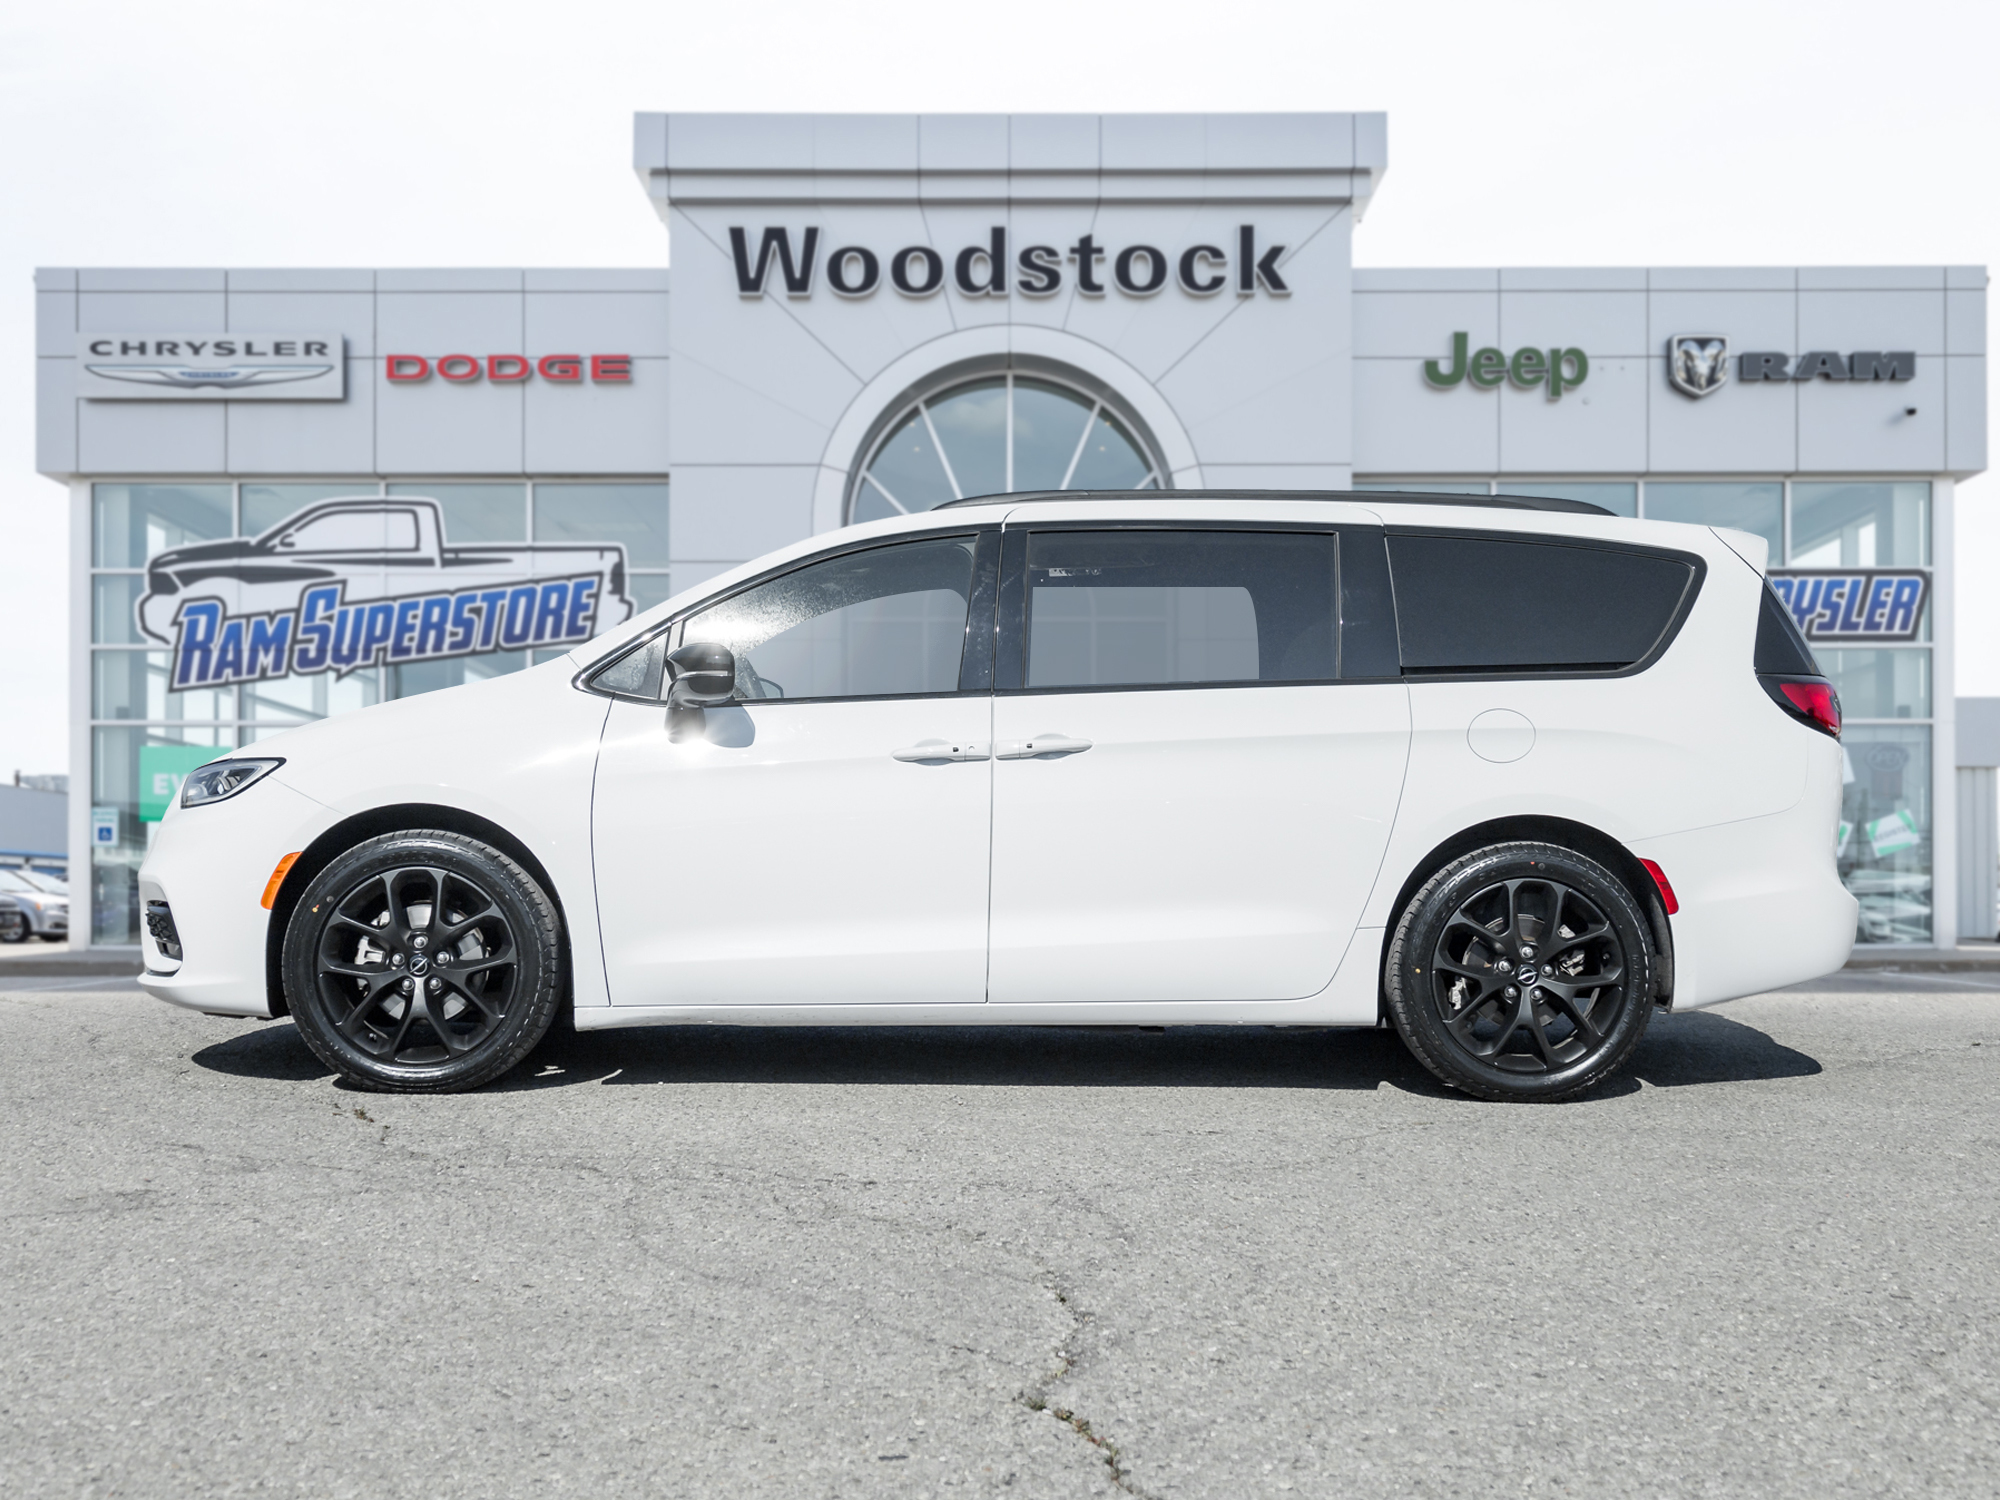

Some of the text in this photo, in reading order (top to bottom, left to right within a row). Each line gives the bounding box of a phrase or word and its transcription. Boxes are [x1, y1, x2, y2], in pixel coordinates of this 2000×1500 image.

[729, 225, 1289, 297] Woodstock
[89, 340, 329, 357] CHRYSLER
[385, 354, 631, 380] DODGE
[1424, 331, 1589, 397] Jeep
[1738, 351, 1916, 380] RAM
[178, 578, 599, 686] RAM SUPERSTORE
